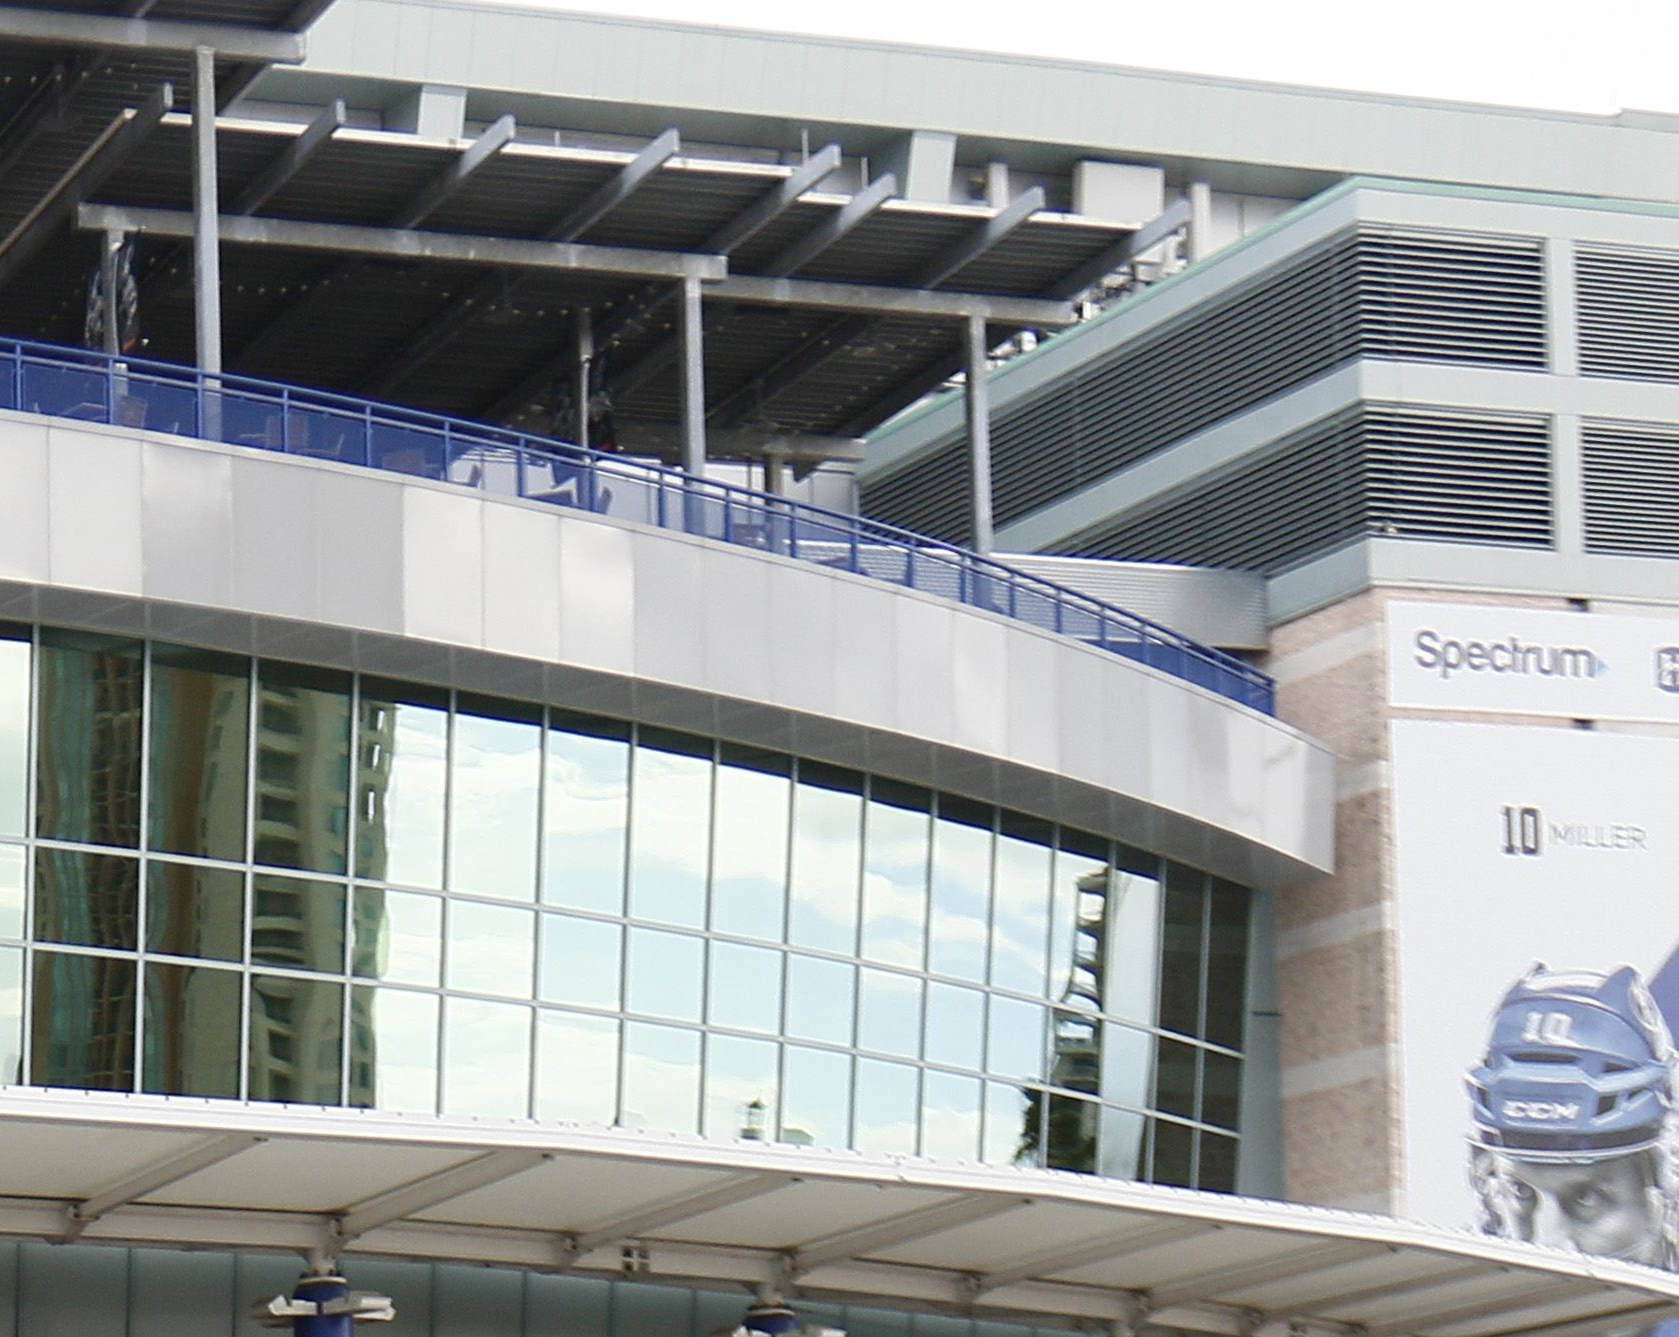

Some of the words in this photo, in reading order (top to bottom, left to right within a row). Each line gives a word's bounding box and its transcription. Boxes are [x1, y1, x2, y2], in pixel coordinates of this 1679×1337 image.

[1414, 630, 1595, 679] Spectrum
[1502, 806, 1540, 854] 10
[1551, 824, 1646, 849] MILLER
[1502, 1100, 1580, 1122] CCM
